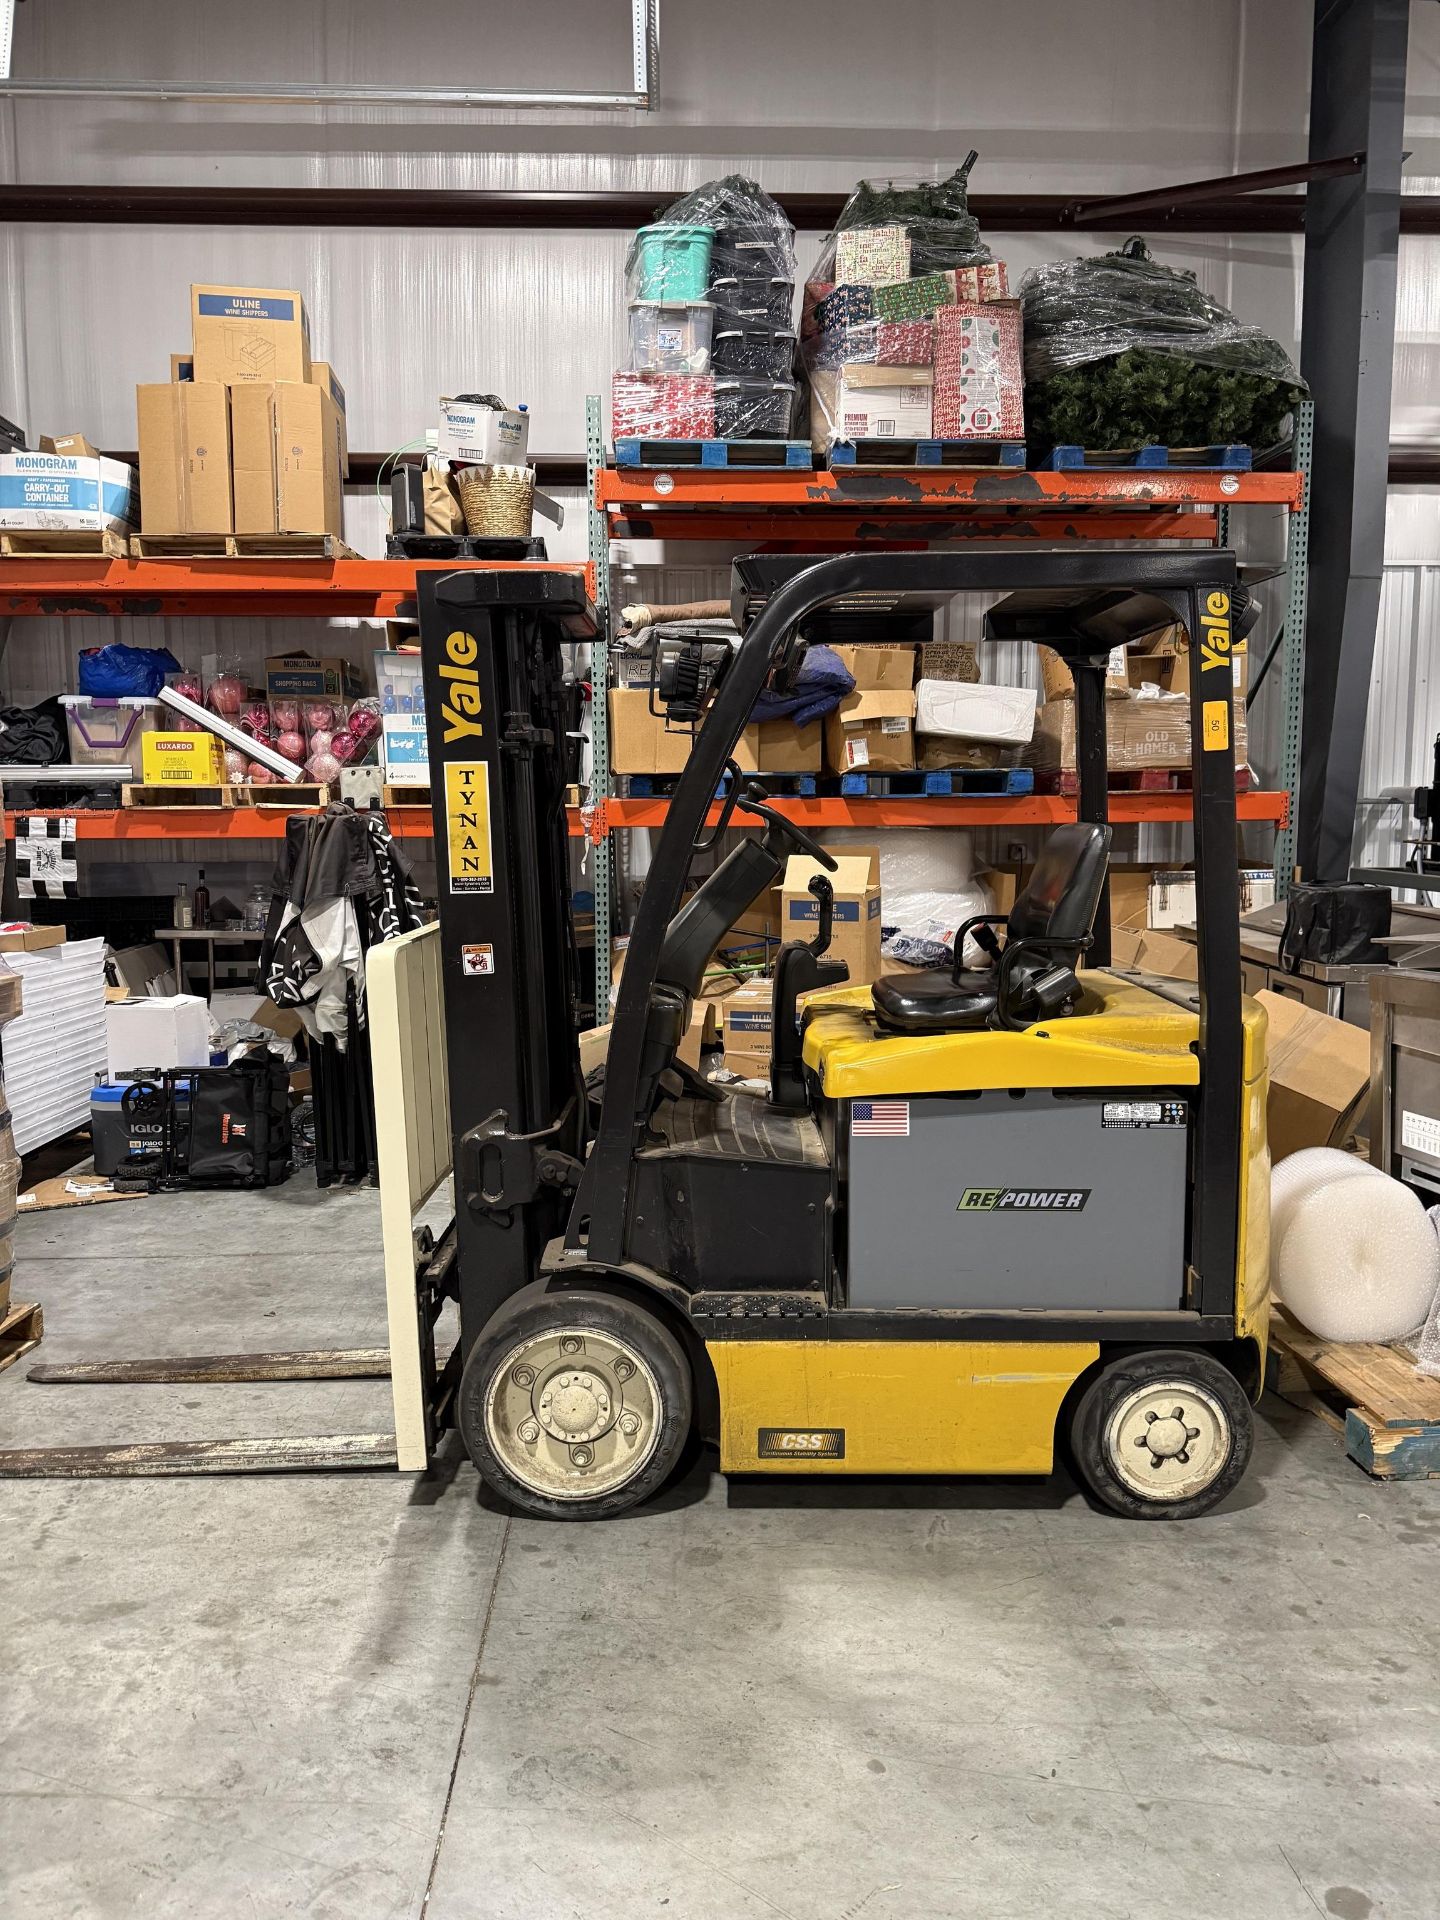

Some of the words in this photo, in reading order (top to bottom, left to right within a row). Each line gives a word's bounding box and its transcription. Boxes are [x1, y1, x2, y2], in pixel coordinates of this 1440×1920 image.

[232, 299, 261, 309] ULINE
[844, 413, 868, 421] PREMIUM
[15, 457, 77, 470] MONOGRAM
[24, 483, 70, 493] CARRY-OUT
[25, 493, 69, 503] CONTAINER
[1200, 591, 1230, 673] Yale
[283, 660, 321, 668] MONOGRAM
[438, 630, 483, 744] Yale
[1211, 719, 1220, 732] 50
[1145, 731, 1169, 742] OLD
[1135, 741, 1177, 756] HAMER
[459, 769, 480, 872] TYNAN
[130, 1124, 168, 1134] IGLO
[998, 1192, 1084, 1208] POWER
[780, 1434, 824, 1449] CSS
[793, 1450, 817, 1458] Stability
[817, 1450, 839, 1458] System
